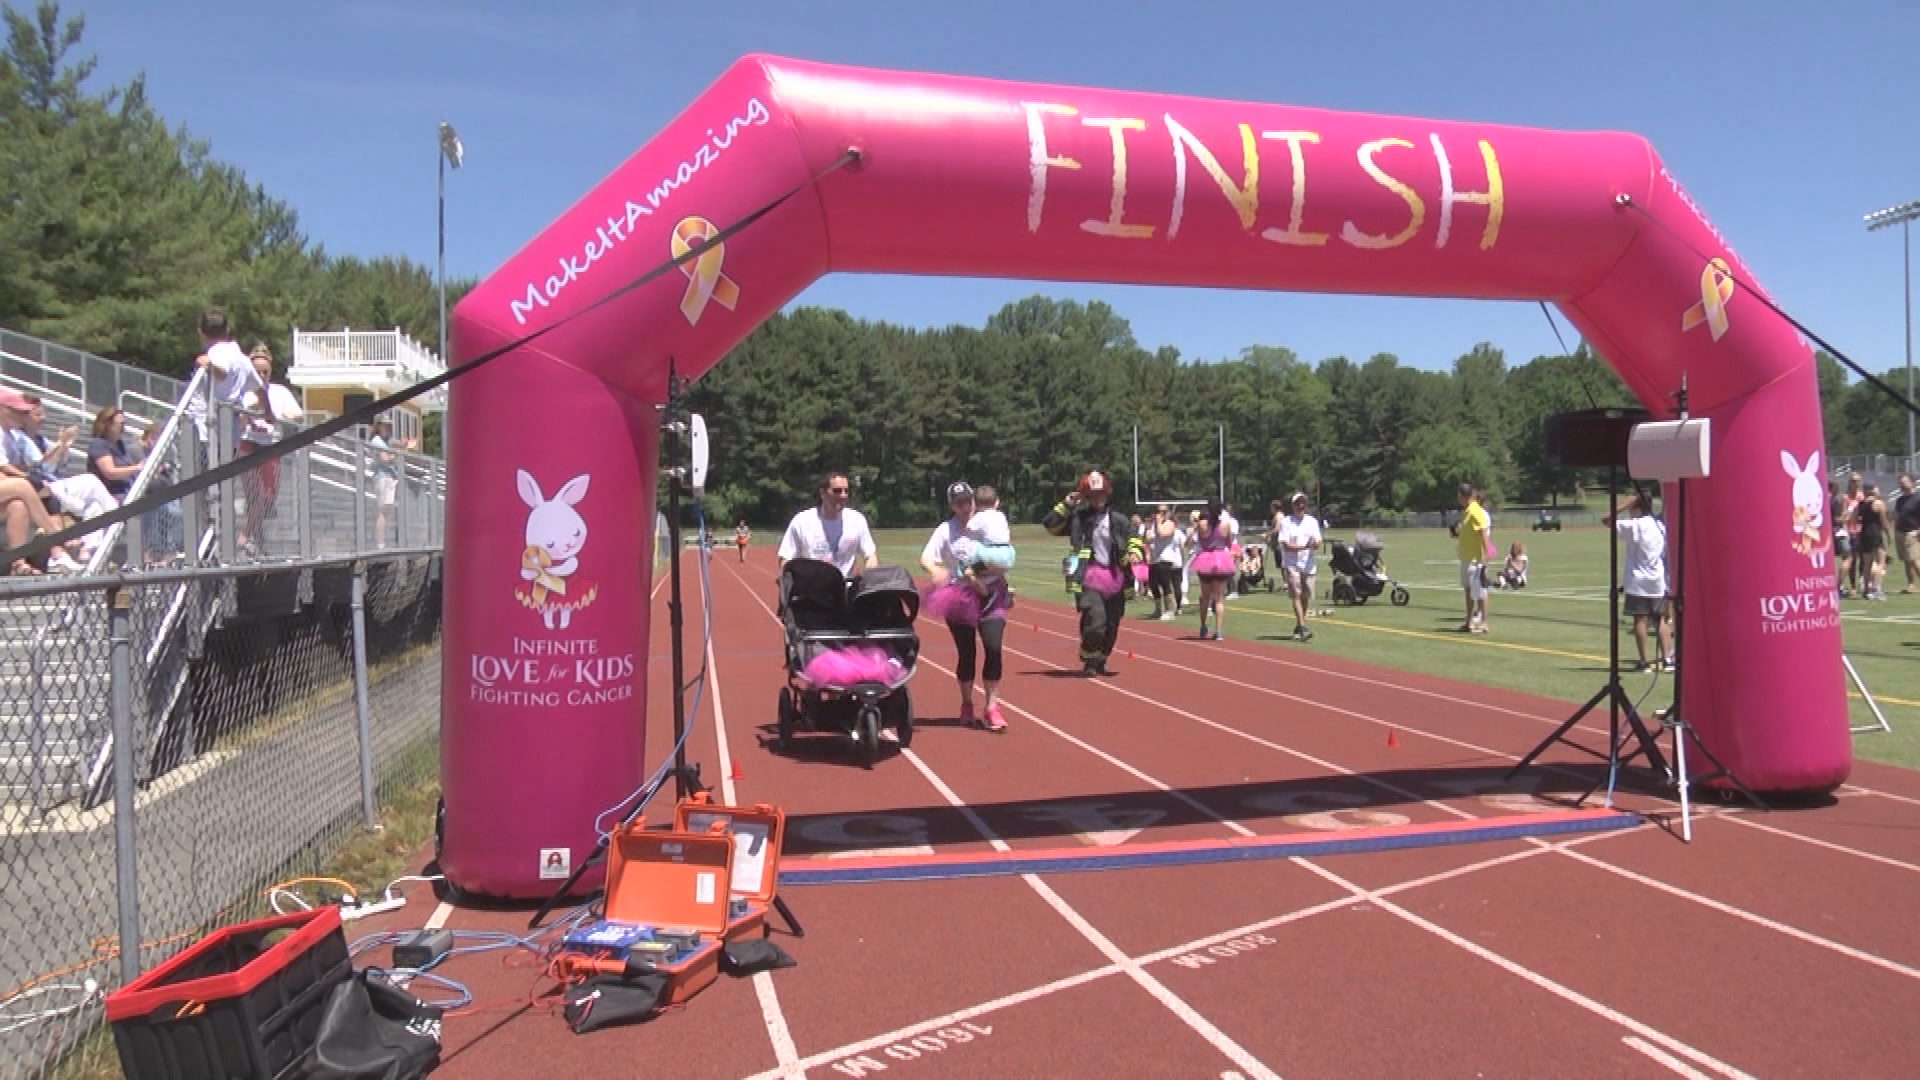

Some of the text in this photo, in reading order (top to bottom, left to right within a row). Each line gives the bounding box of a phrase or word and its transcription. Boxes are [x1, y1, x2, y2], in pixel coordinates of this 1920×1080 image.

[1021, 101, 1503, 251] FINISH
[510, 97, 769, 325] MakeItAmazing
[1760, 592, 1816, 620] LOVE
[1762, 617, 1828, 635] FIGHTING
[513, 637, 598, 656] INFINITE
[471, 654, 634, 687] LOVE for KIDS
[471, 685, 633, 707] FIGHTING CANCER
[1170, 953, 1217, 969] M
[831, 1021, 993, 1079] 1600 M
